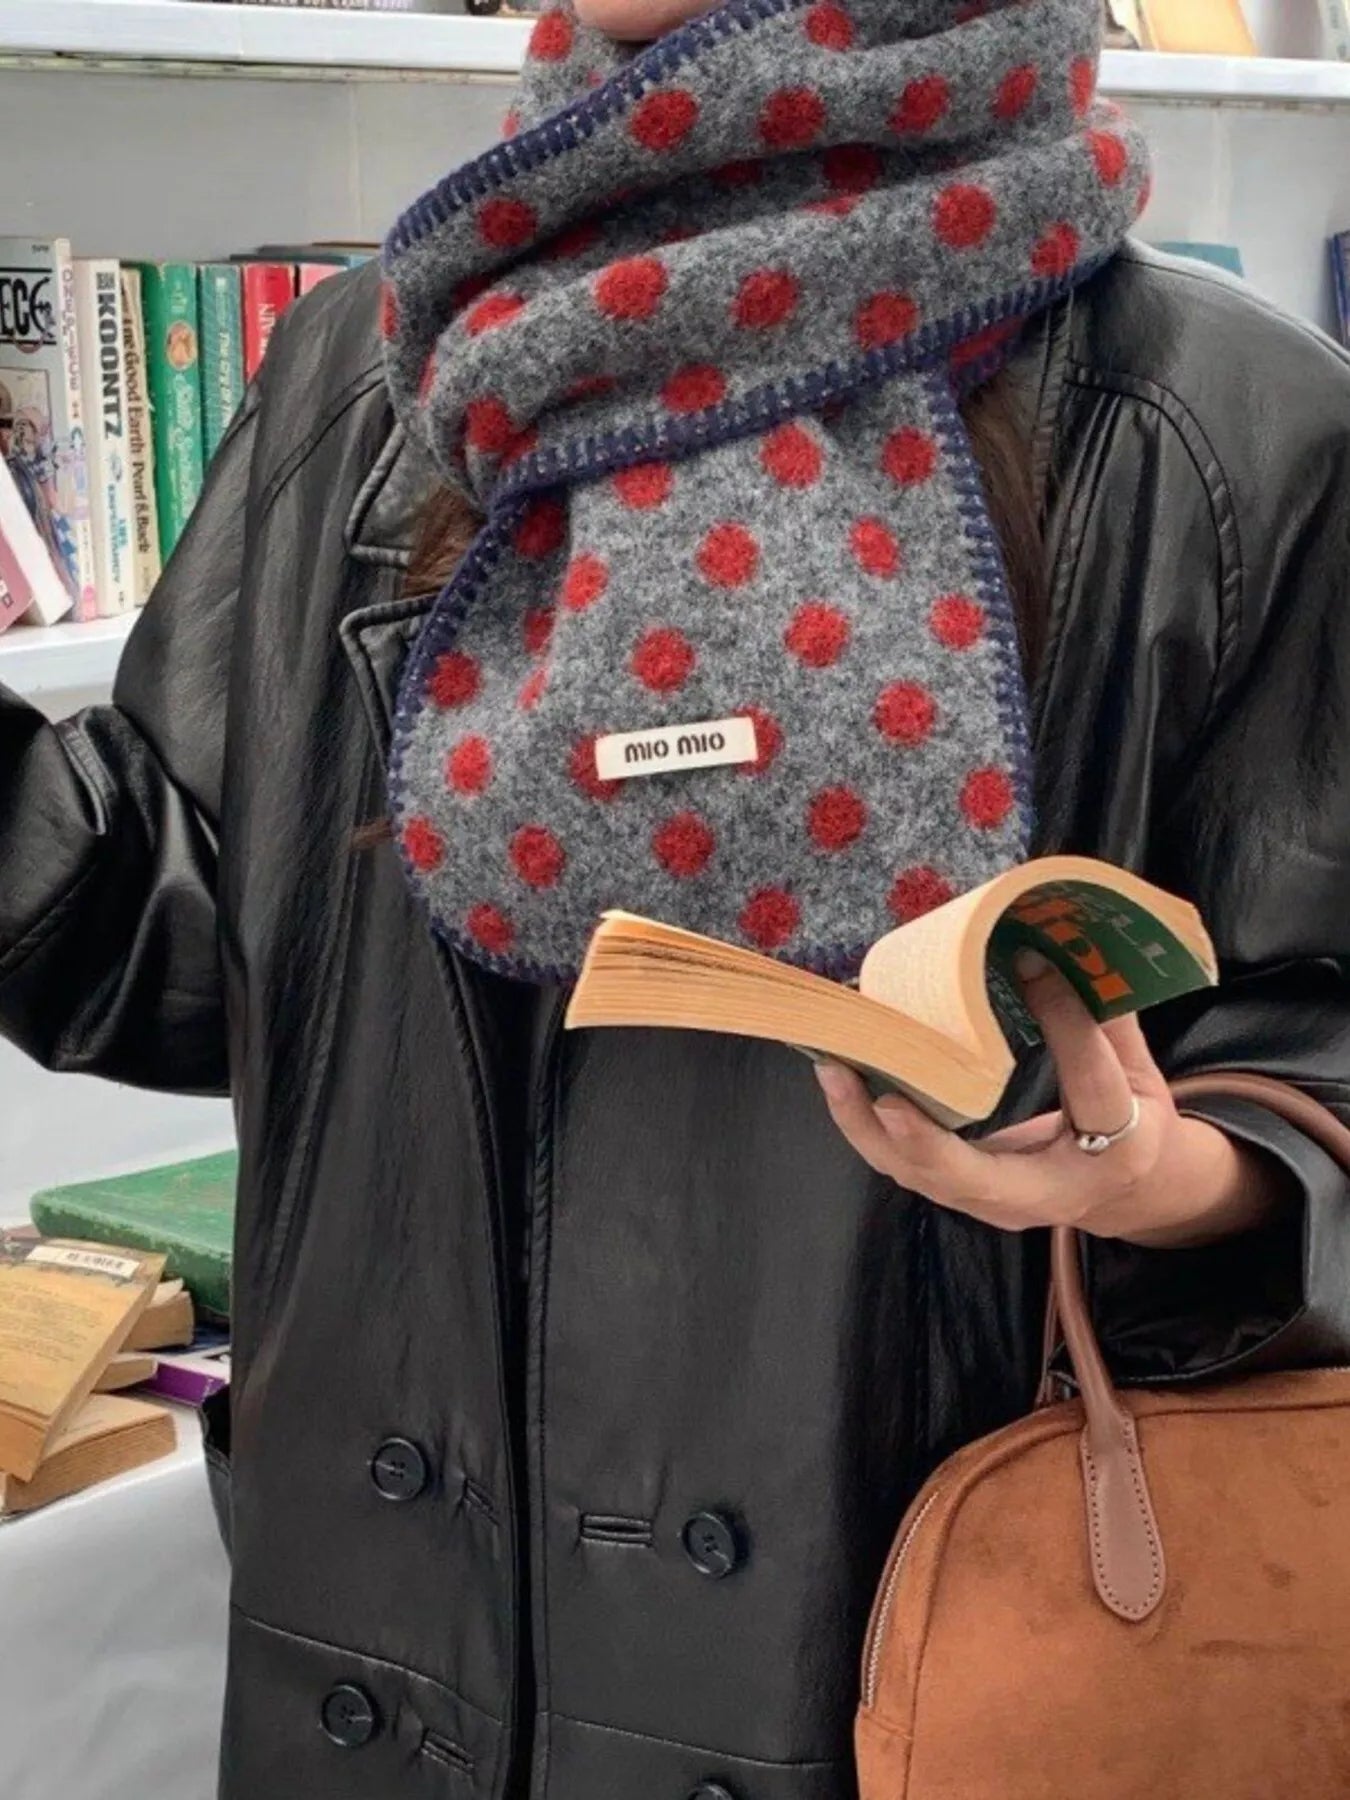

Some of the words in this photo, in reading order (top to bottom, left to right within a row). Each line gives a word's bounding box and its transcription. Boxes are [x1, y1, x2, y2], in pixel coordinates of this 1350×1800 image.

[97, 292, 122, 440] KOONTZ
[124, 350, 141, 402] Good
[127, 405, 146, 453] Earth
[131, 461, 148, 501] Pearl
